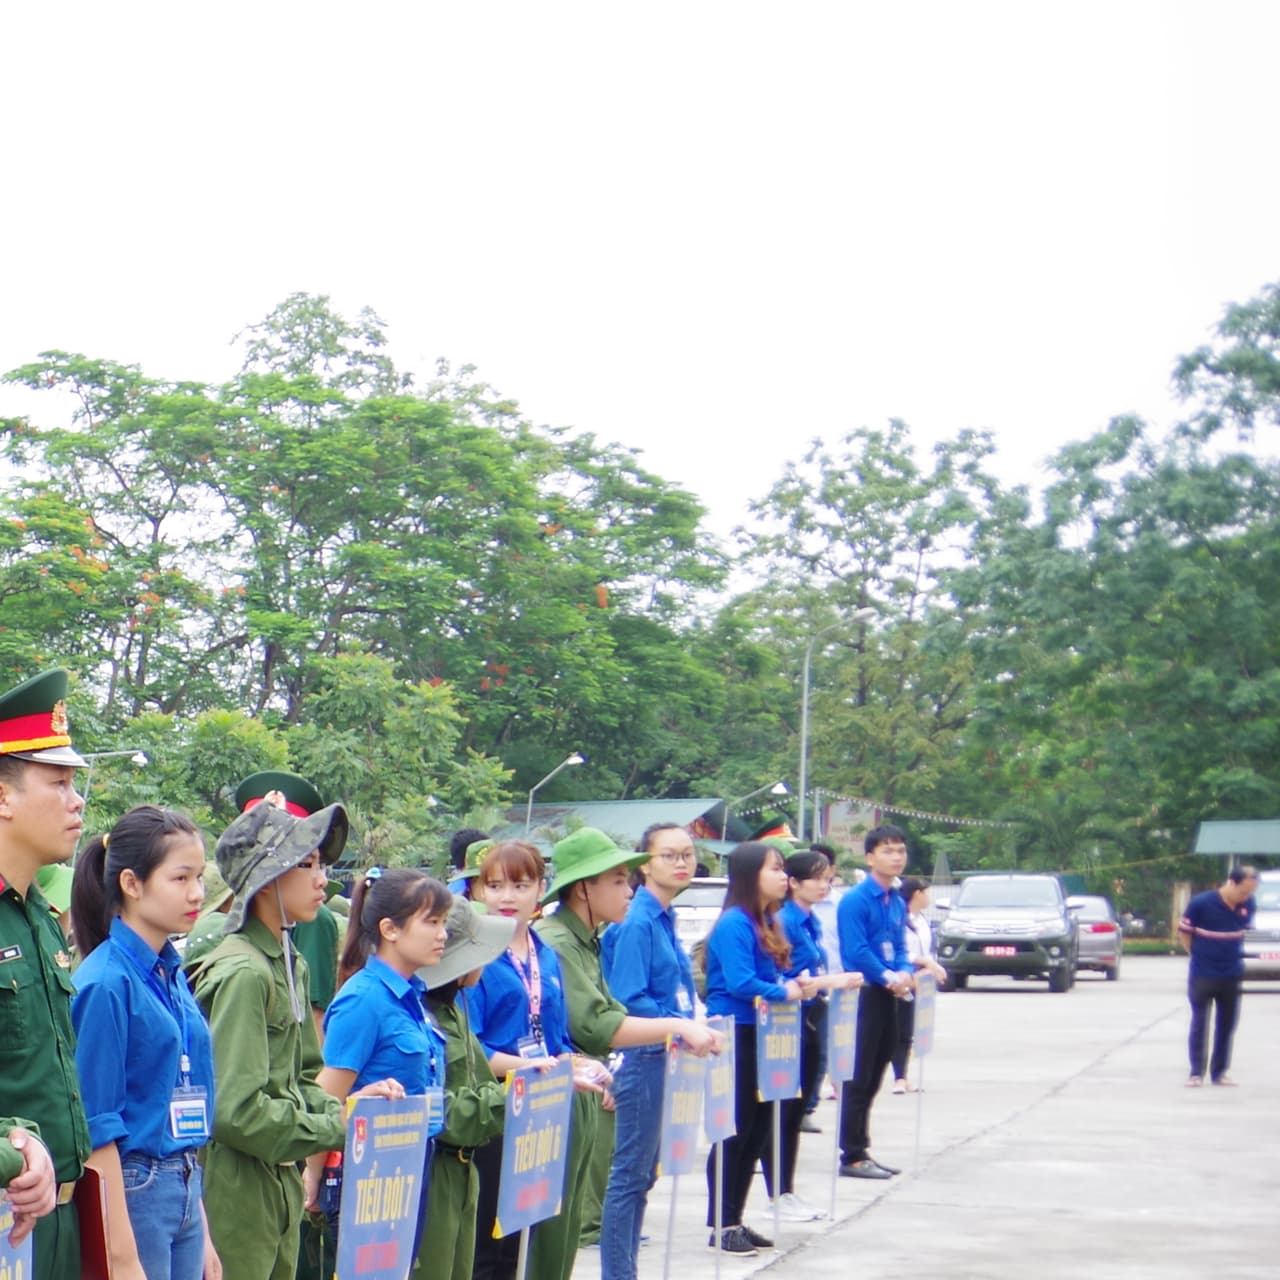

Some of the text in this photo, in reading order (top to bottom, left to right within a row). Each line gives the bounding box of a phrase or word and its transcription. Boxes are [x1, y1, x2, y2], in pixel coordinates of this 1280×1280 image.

[355, 1160, 415, 1229] TIỂU ĐỘI 7
